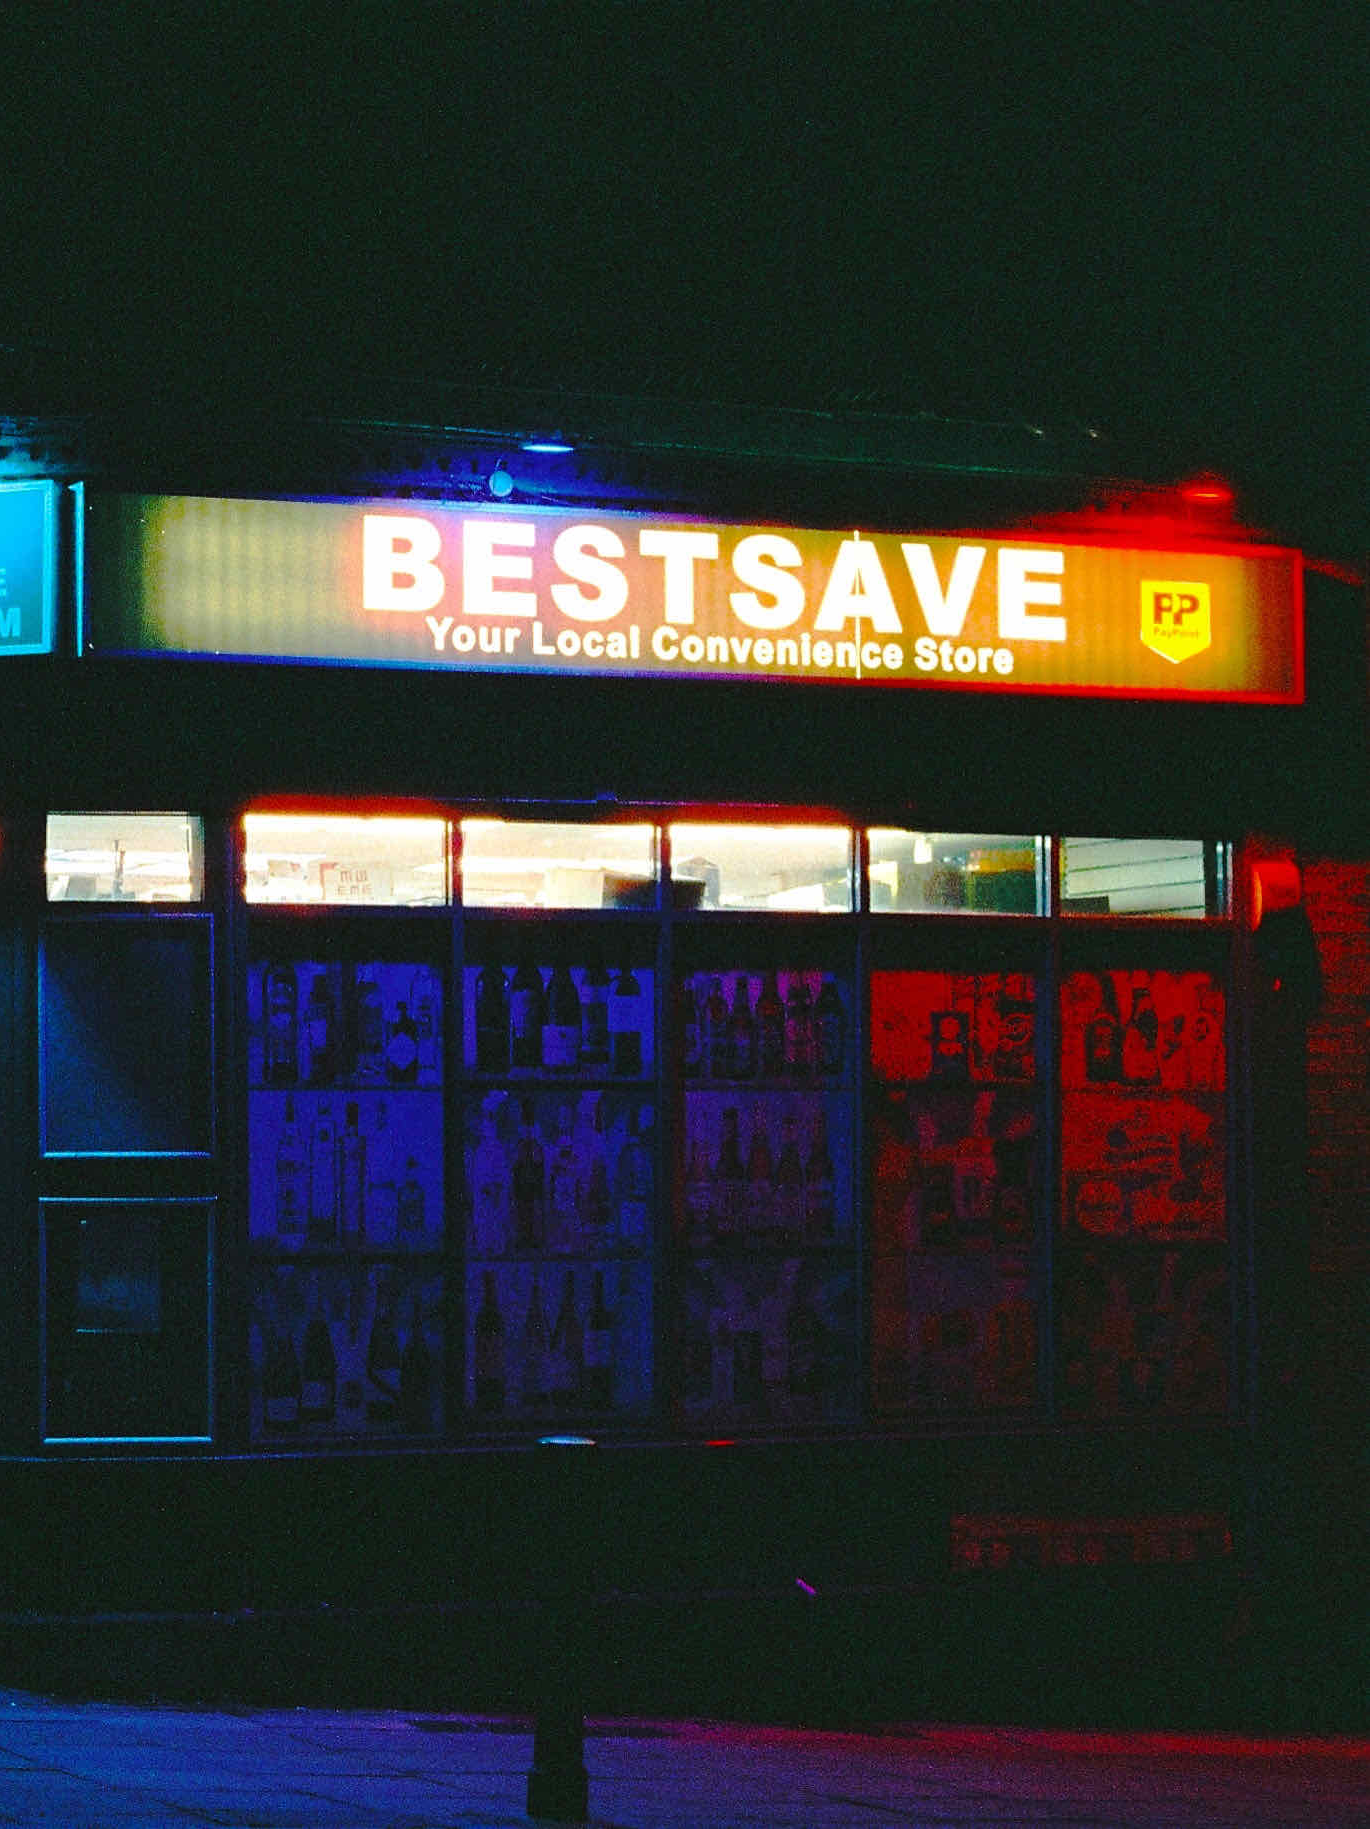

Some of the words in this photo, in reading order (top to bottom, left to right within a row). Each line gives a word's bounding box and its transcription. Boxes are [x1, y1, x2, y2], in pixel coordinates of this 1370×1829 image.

[363, 515, 1066, 641] BESTSAVE
[426, 616, 521, 653] Your
[533, 621, 640, 659] Local
[652, 626, 903, 669] Convenience
[915, 637, 1014, 674] Store
